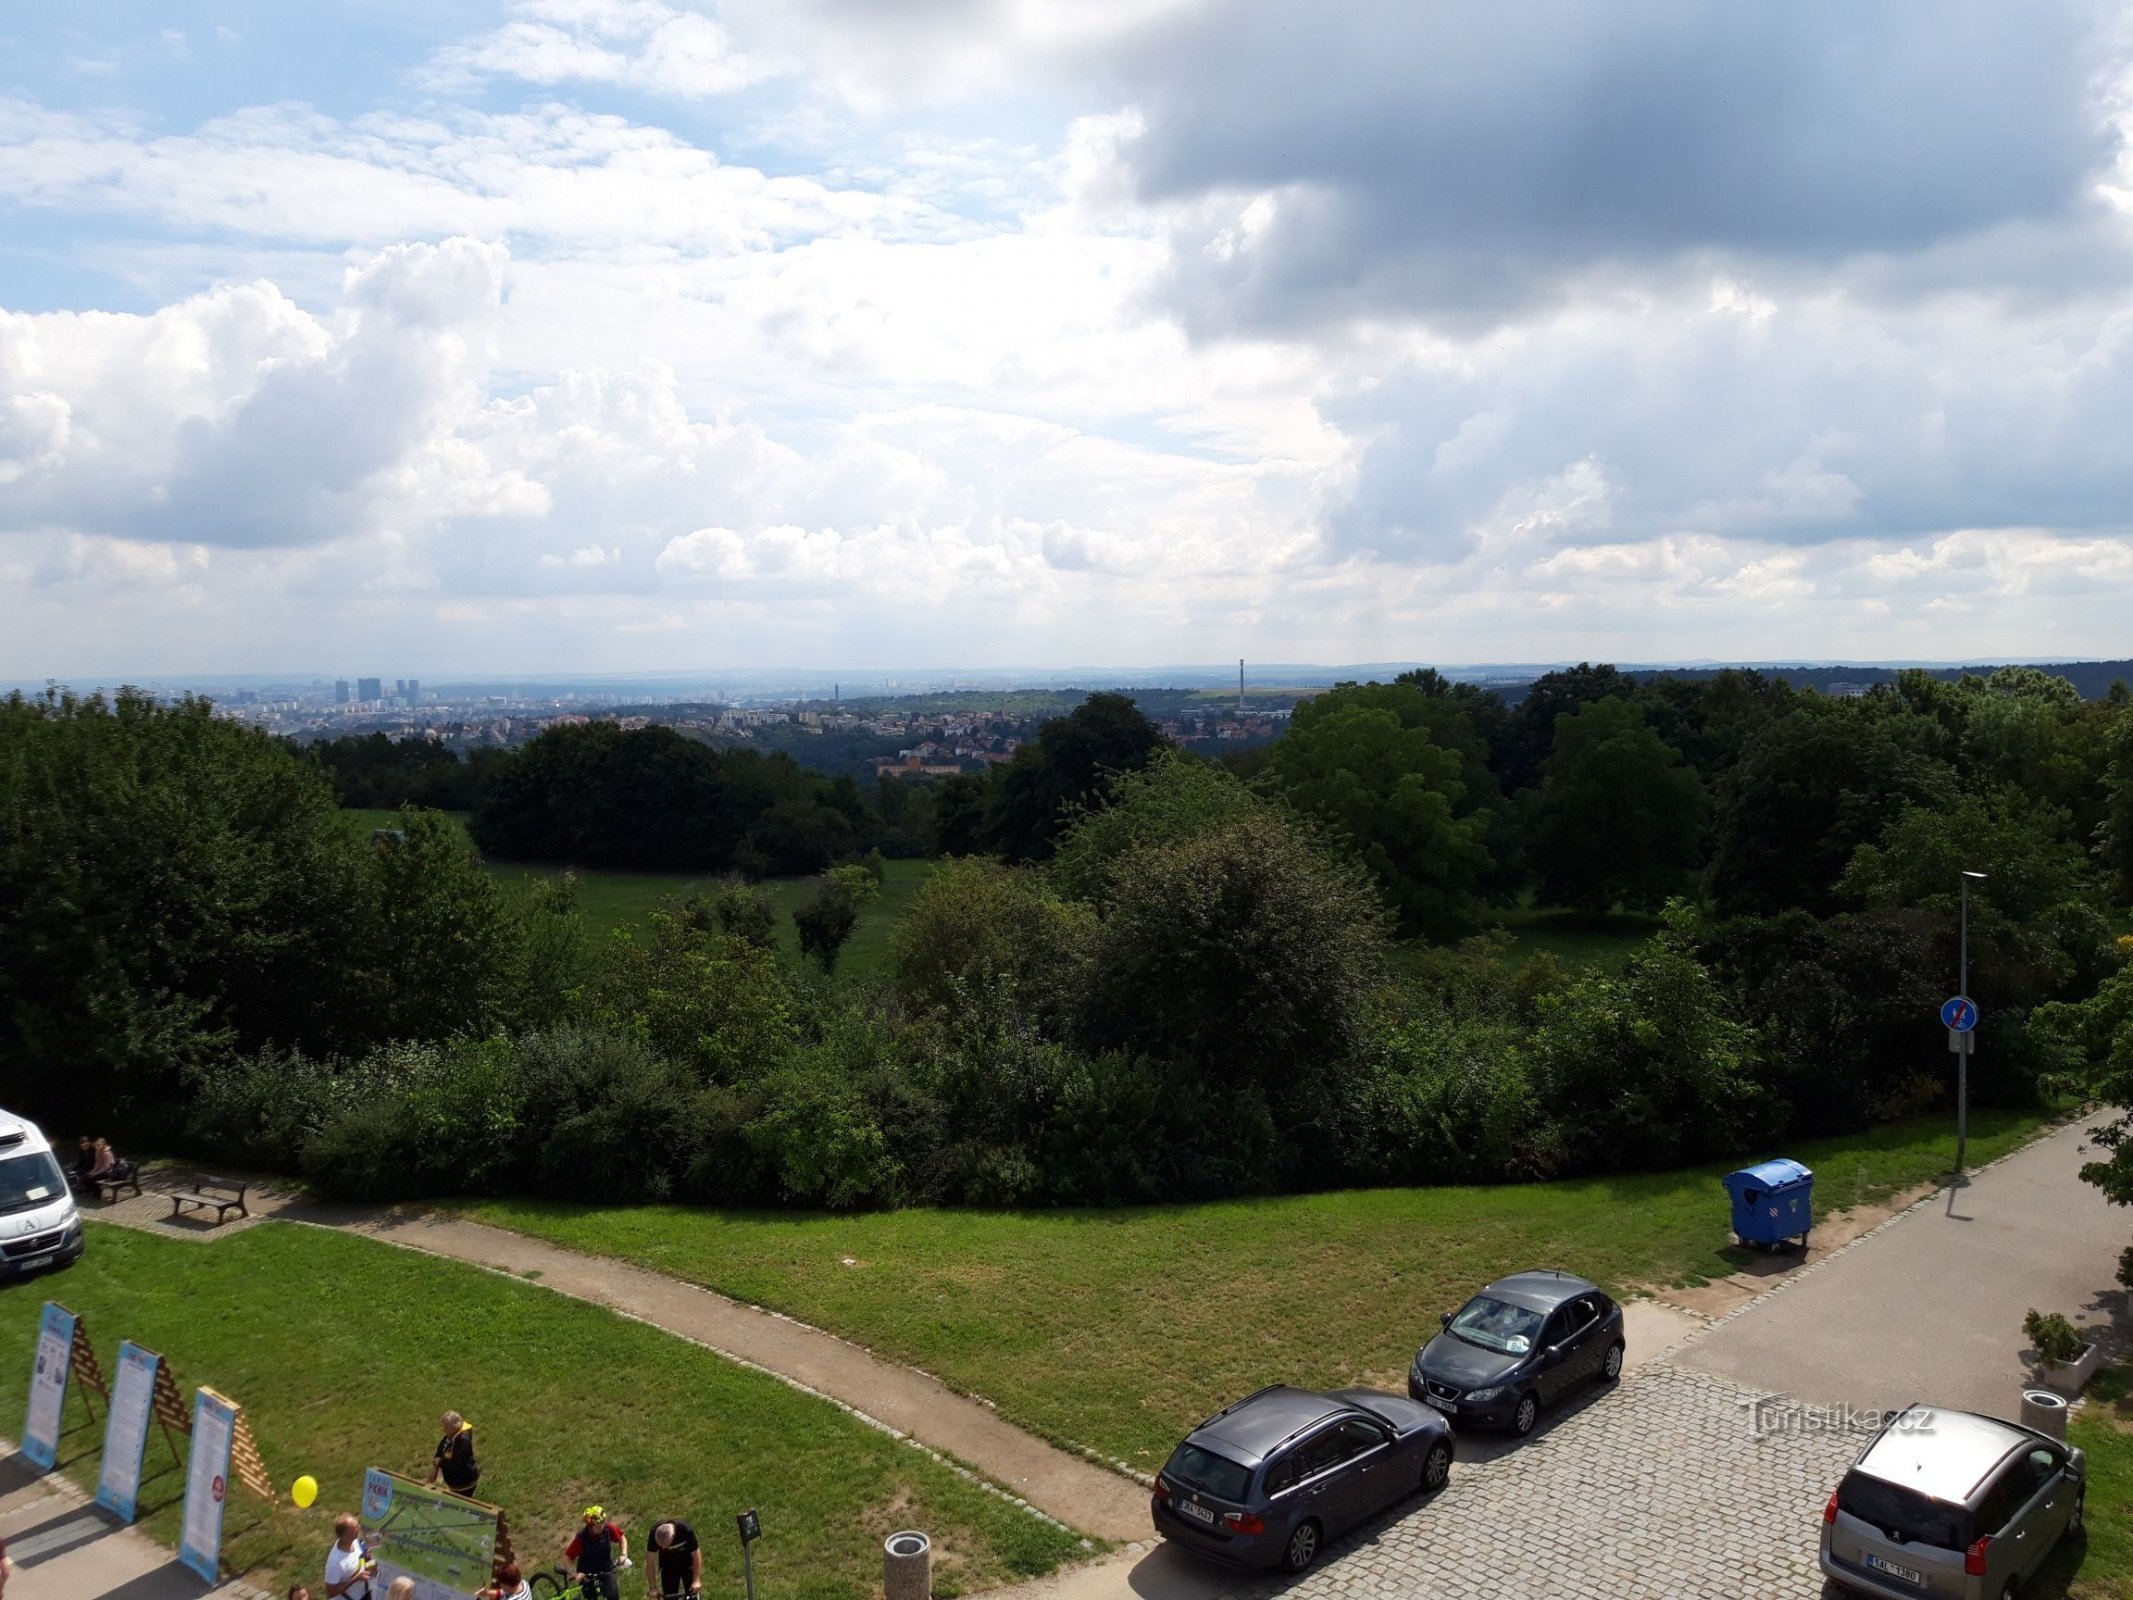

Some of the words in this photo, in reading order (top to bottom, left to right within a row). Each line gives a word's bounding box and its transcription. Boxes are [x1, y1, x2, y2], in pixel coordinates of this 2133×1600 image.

[24, 1220, 35, 1231] A
[1875, 1558, 1888, 1570] 5AL
[1896, 1566, 1916, 1580] 1380
